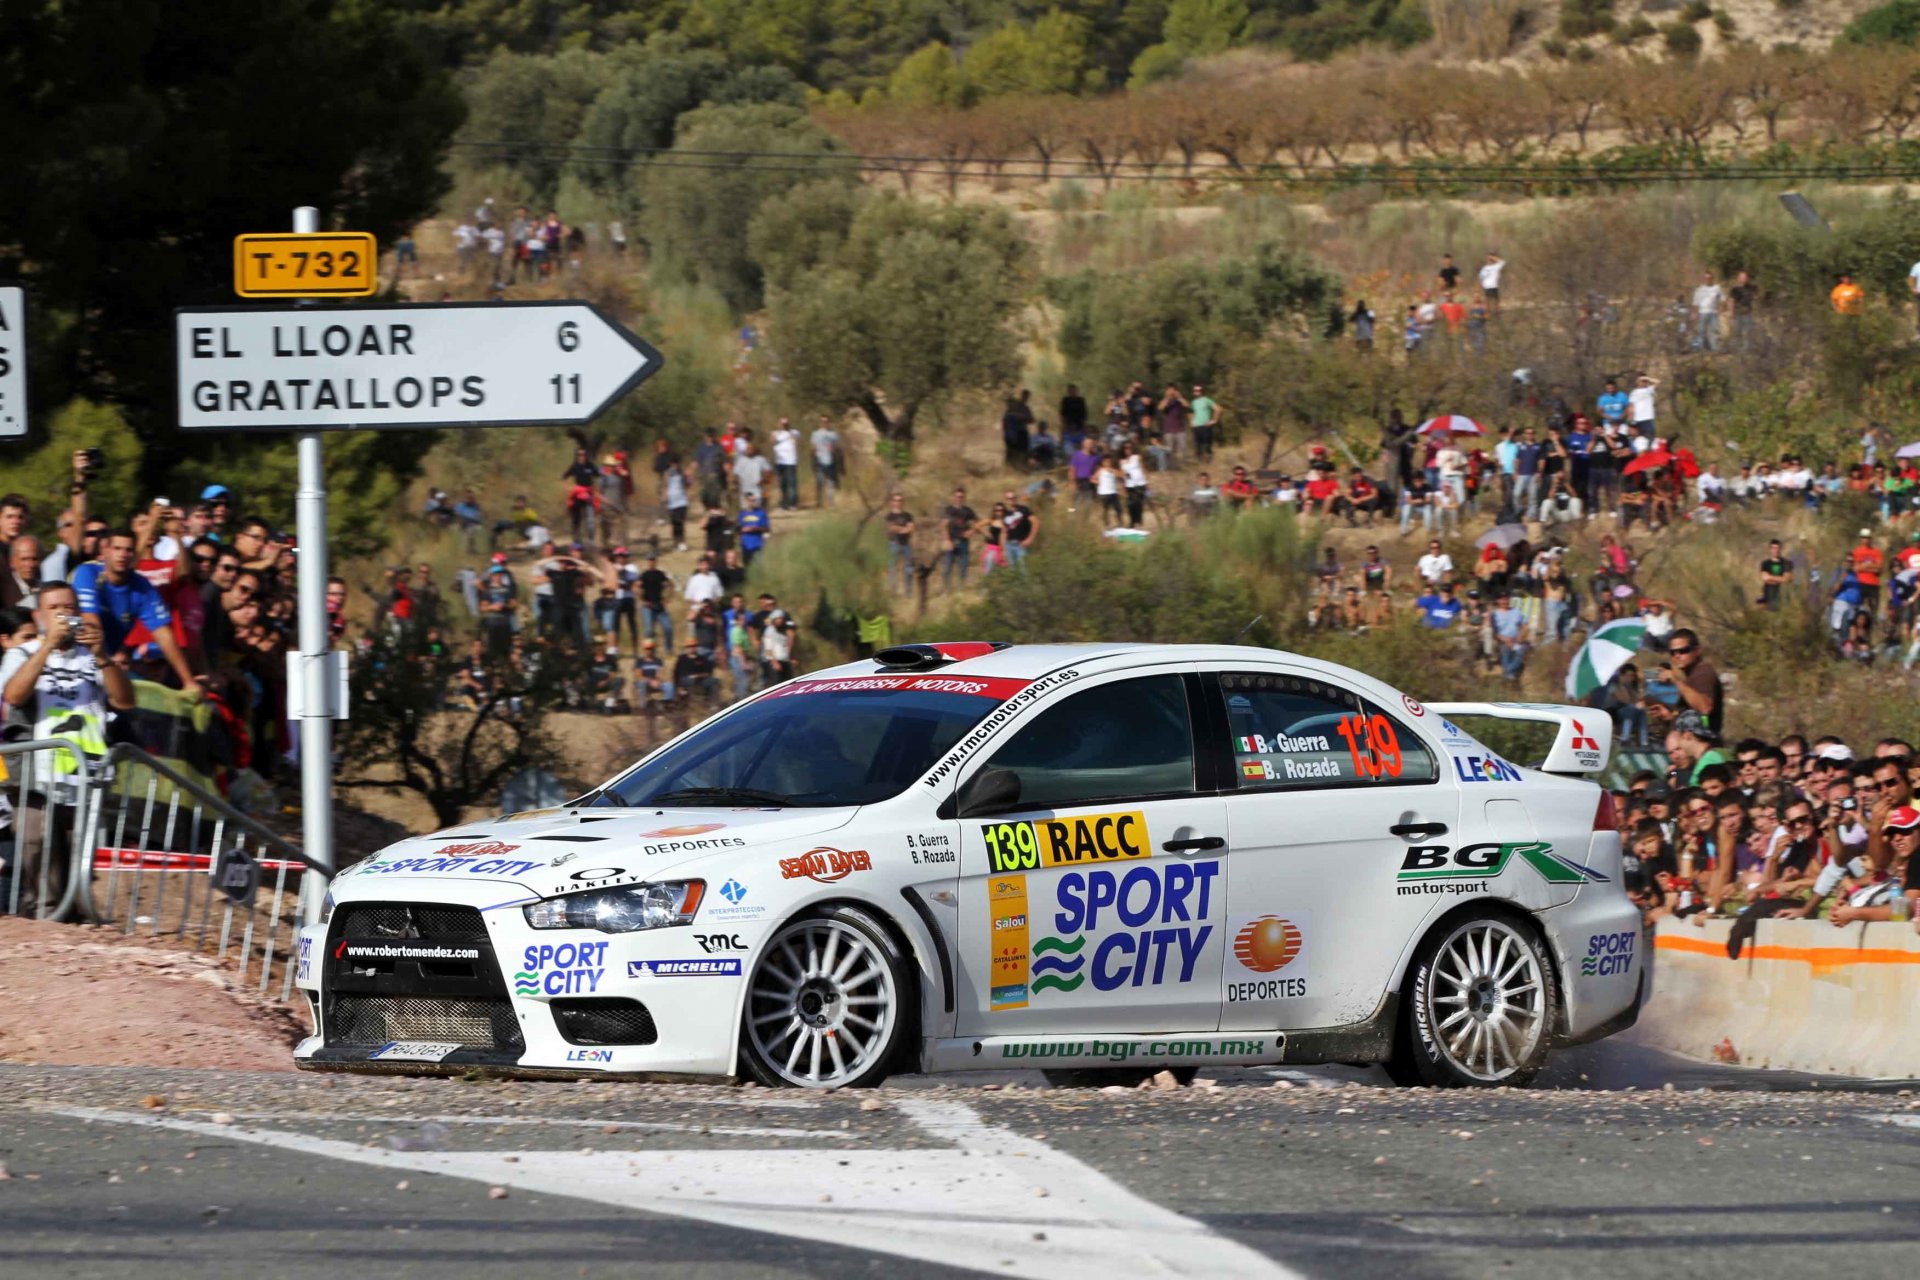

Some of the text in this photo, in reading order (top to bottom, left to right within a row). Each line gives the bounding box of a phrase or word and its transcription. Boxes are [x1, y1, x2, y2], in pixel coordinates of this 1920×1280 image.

[251, 252, 360, 280] T-732
[191, 320, 580, 360] EL LLOAR 6
[192, 373, 582, 413] GRATALLOPS 11
[809, 678, 988, 694] MITSUBISHI MOTORS
[924, 666, 1080, 788] www.rmcmotorsport.es
[1253, 732, 1330, 754] B. Guerra
[1337, 713, 1403, 778] 139
[1262, 756, 1341, 780] B. Rozada
[643, 837, 746, 856] DEPORTES
[907, 833, 949, 848] B. Guerra
[985, 815, 1141, 871] 139 RACC
[381, 857, 478, 873] SPORT
[469, 859, 546, 876] CITY
[827, 849, 873, 873] BAKER
[911, 848, 956, 864] B. Rozada
[555, 875, 640, 893] OAKLEY
[1396, 880, 1489, 896] motorsport
[1054, 860, 1220, 935] SPORT
[995, 917, 1025, 930] Salou
[347, 944, 479, 959] www.robertomendez.com
[1588, 932, 1636, 956] SPORT
[523, 941, 609, 972] SPORT
[656, 960, 737, 974] MICHELIN
[1090, 925, 1214, 991] CITY
[1598, 953, 1634, 976] CITY
[543, 968, 606, 996] CITY
[1228, 977, 1307, 1002] DEPORTES
[1414, 965, 1433, 1042] MICHELIN
[1002, 1040, 1264, 1062] www.bgr.com.mx
